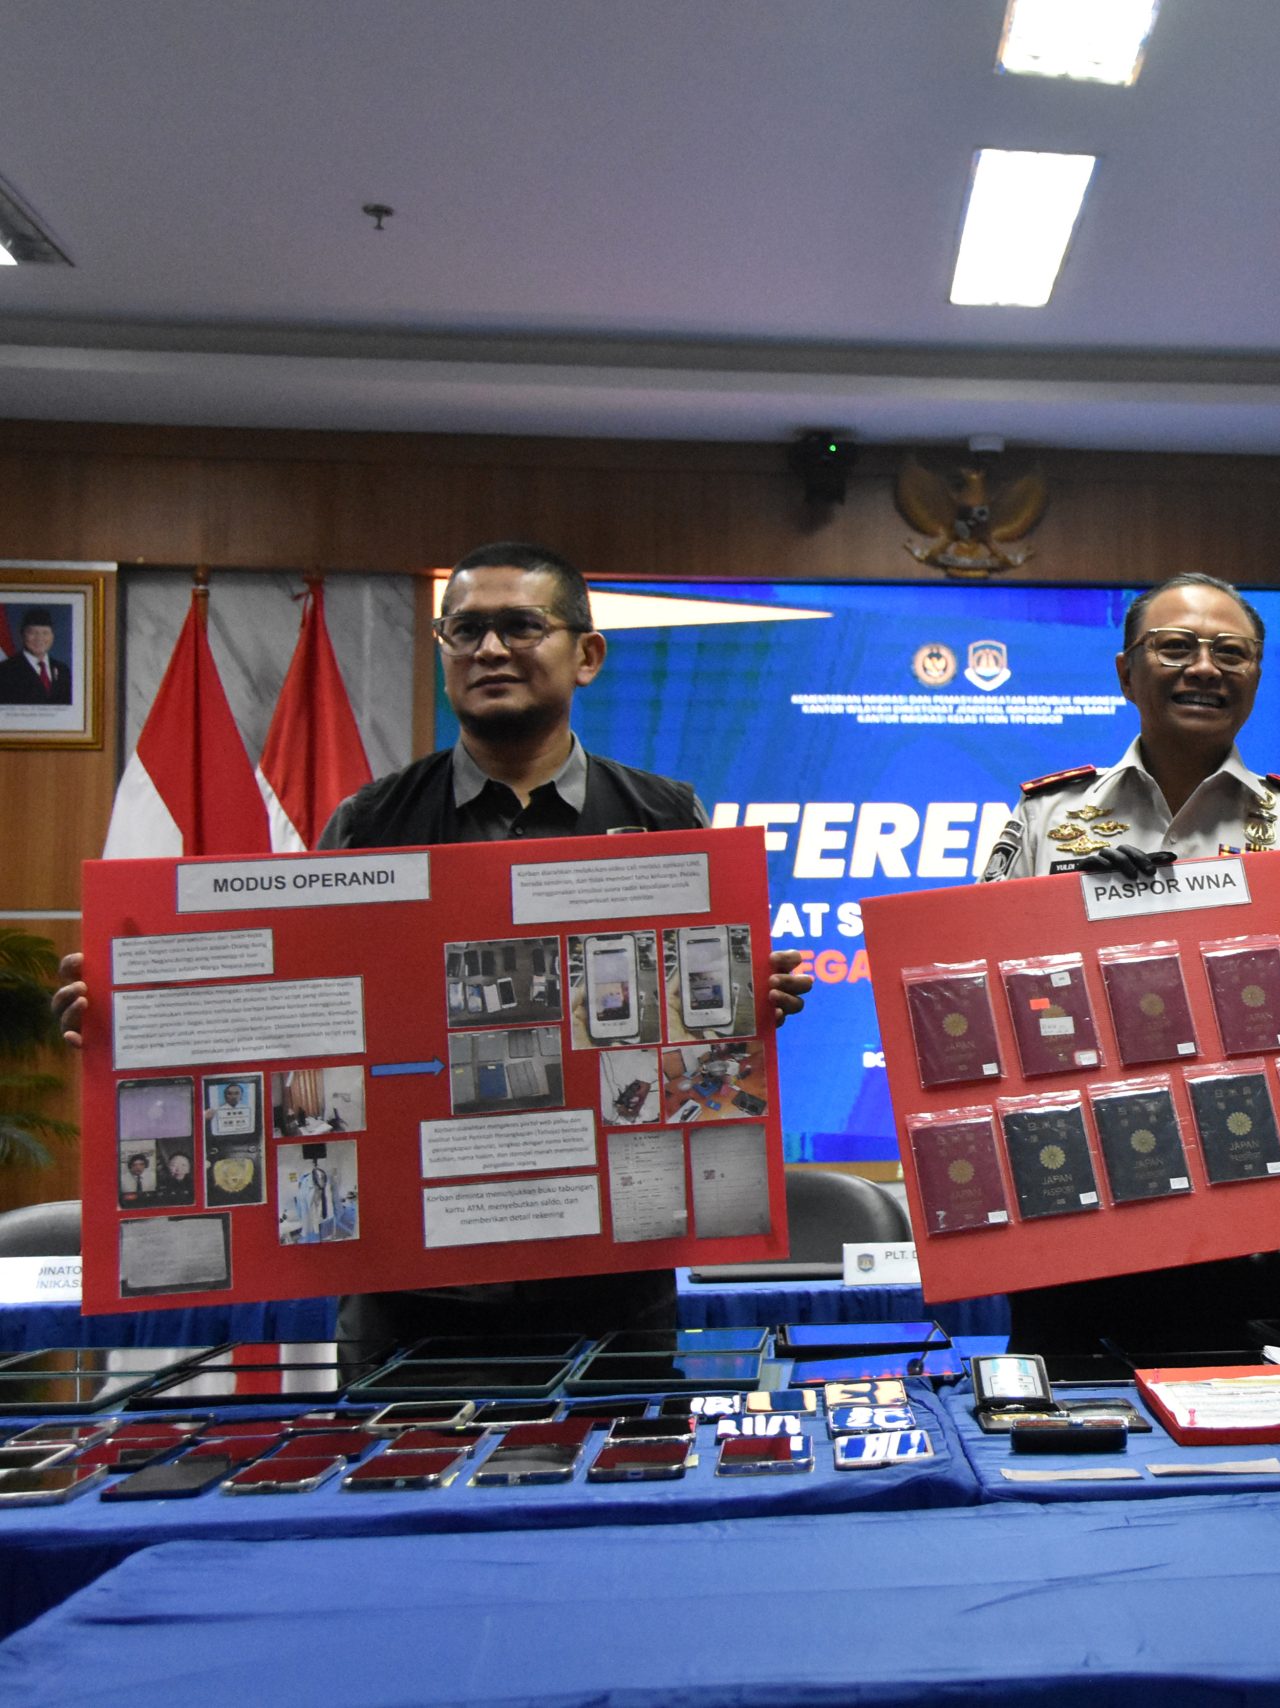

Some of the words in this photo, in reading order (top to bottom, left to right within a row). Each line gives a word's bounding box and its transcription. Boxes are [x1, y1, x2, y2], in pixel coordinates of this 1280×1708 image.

[213, 874, 287, 893] MODUS
[292, 870, 396, 889] OPERANDI
[1094, 877, 1182, 901] PASPOR
[1185, 872, 1237, 891] WNA
[885, 1250, 908, 1260] PLT.
